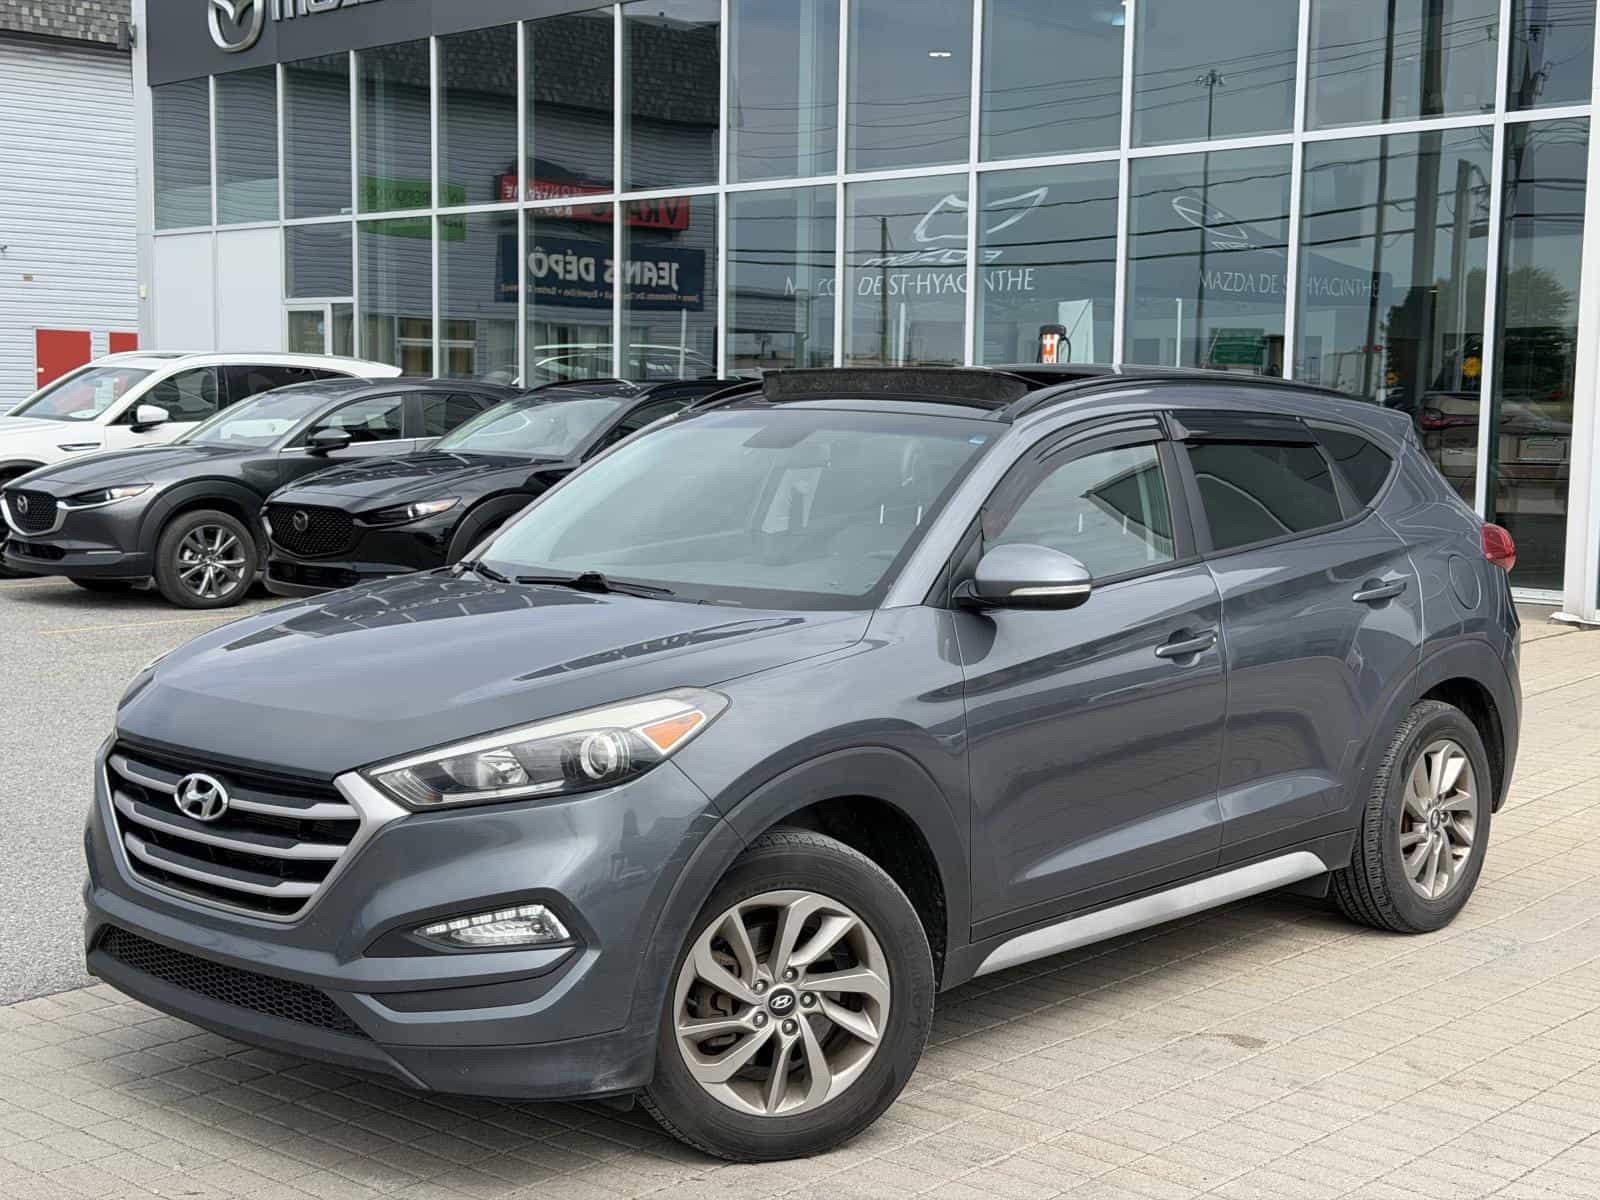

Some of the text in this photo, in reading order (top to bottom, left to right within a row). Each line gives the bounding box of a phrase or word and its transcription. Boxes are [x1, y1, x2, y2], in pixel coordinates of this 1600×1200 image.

[858, 275, 884, 296] DE
[888, 268, 1035, 296] ST-HYACNTHE
[1199, 270, 1256, 294] MAZDA
[1260, 273, 1280, 294] DE
